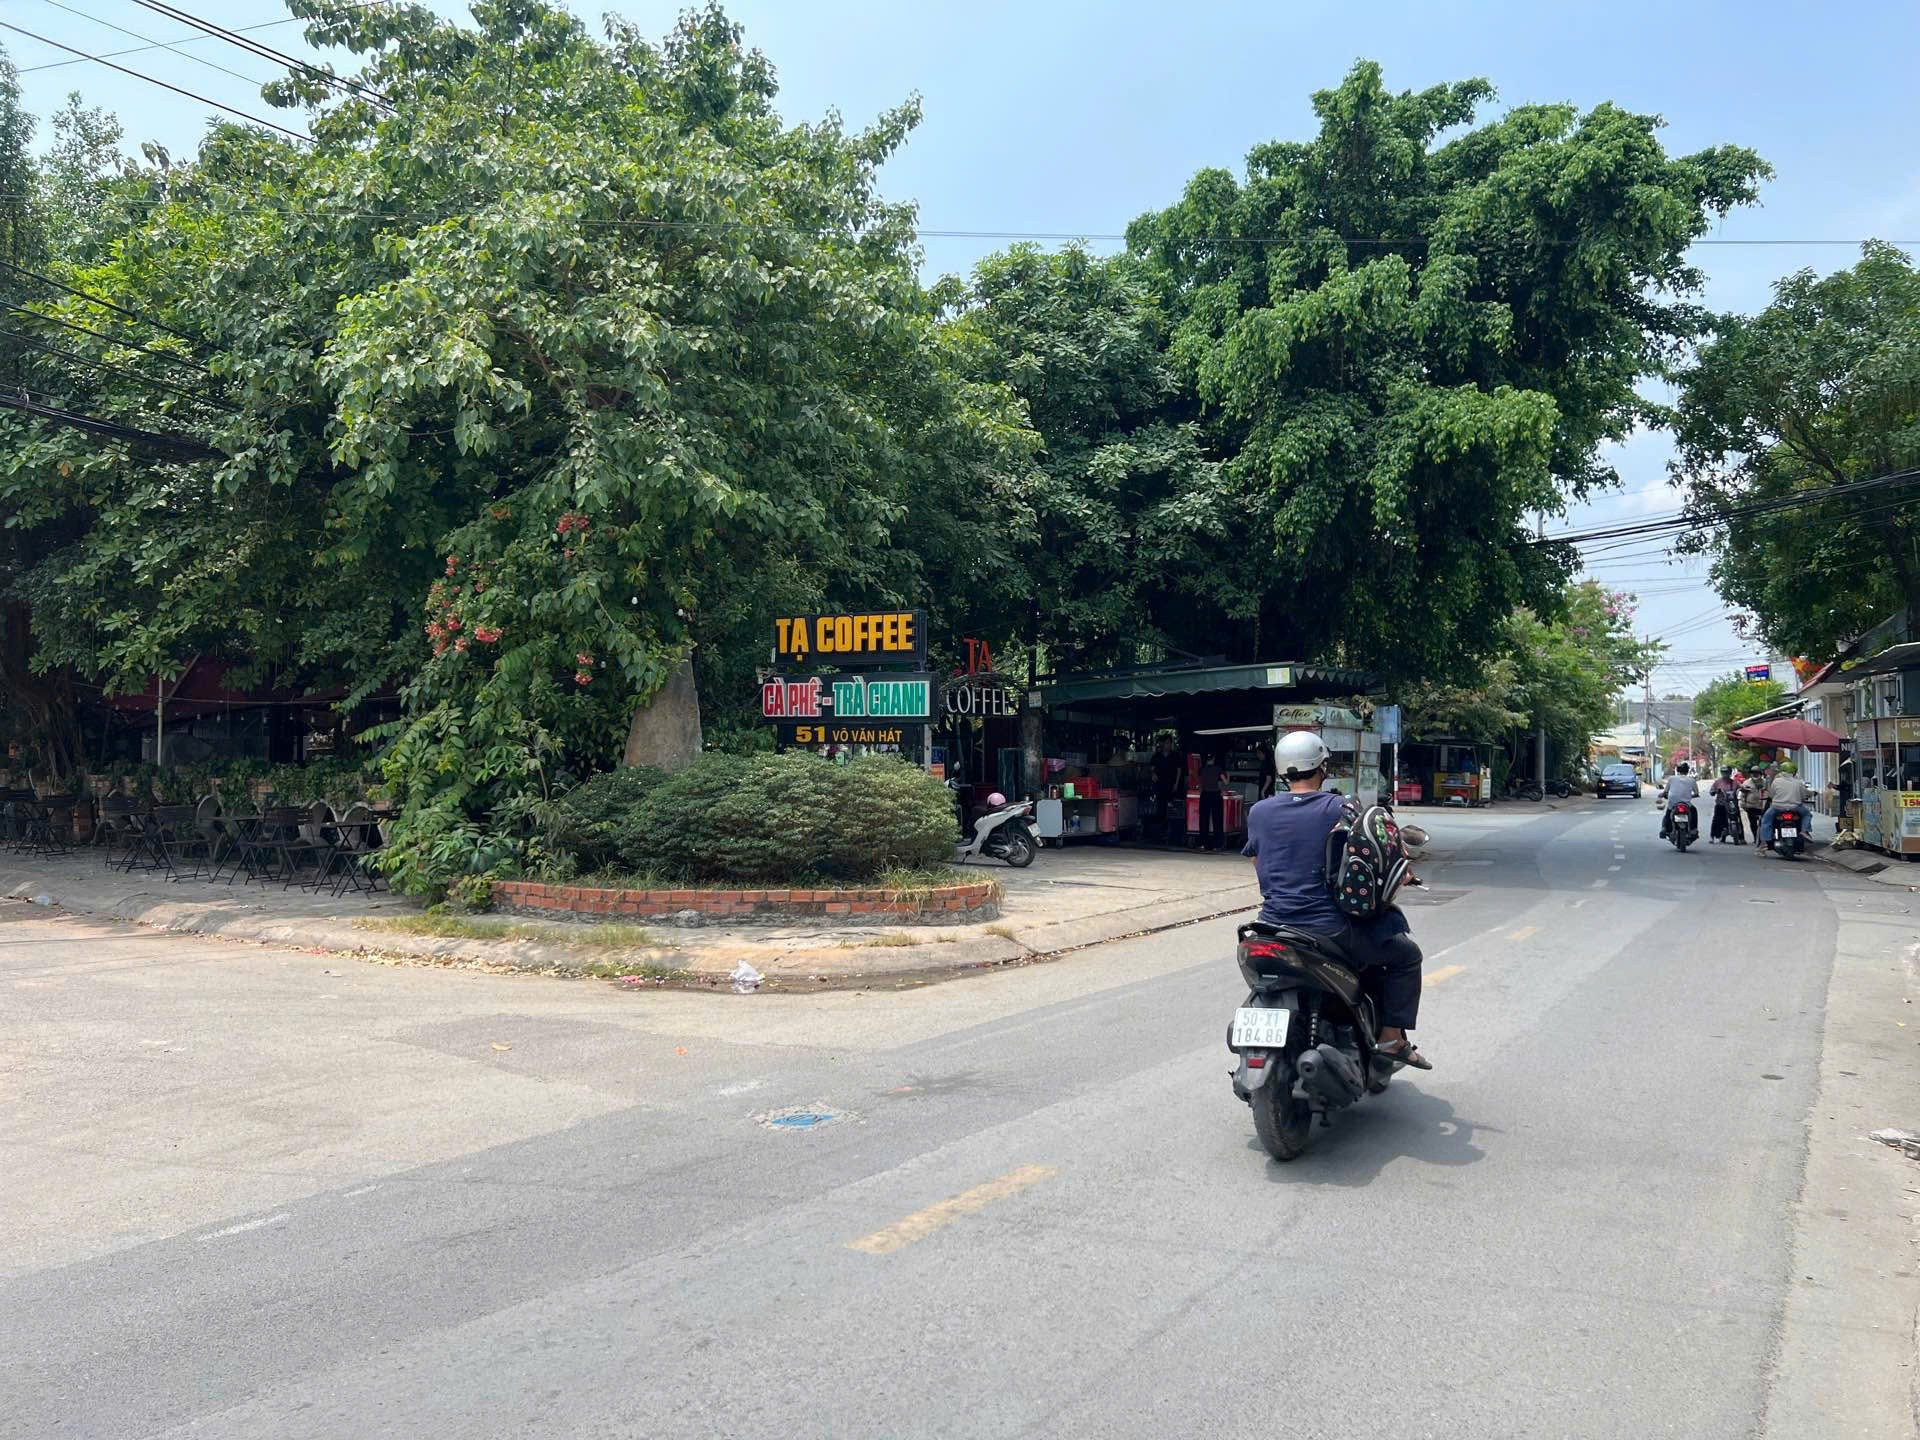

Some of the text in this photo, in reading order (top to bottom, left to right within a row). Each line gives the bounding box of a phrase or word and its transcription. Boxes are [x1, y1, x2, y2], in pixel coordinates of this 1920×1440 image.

[776, 614, 914, 661] TẠ COFFEE
[763, 677, 787, 717] CÀ
[788, 677, 824, 717] PHÊ
[832, 676, 867, 717] TRÀ
[867, 681, 931, 717] CHANH
[946, 685, 1018, 716] COFFEE
[1280, 708, 1312, 720] Coffee
[796, 726, 826, 743] 51
[852, 727, 875, 742] VĂN
